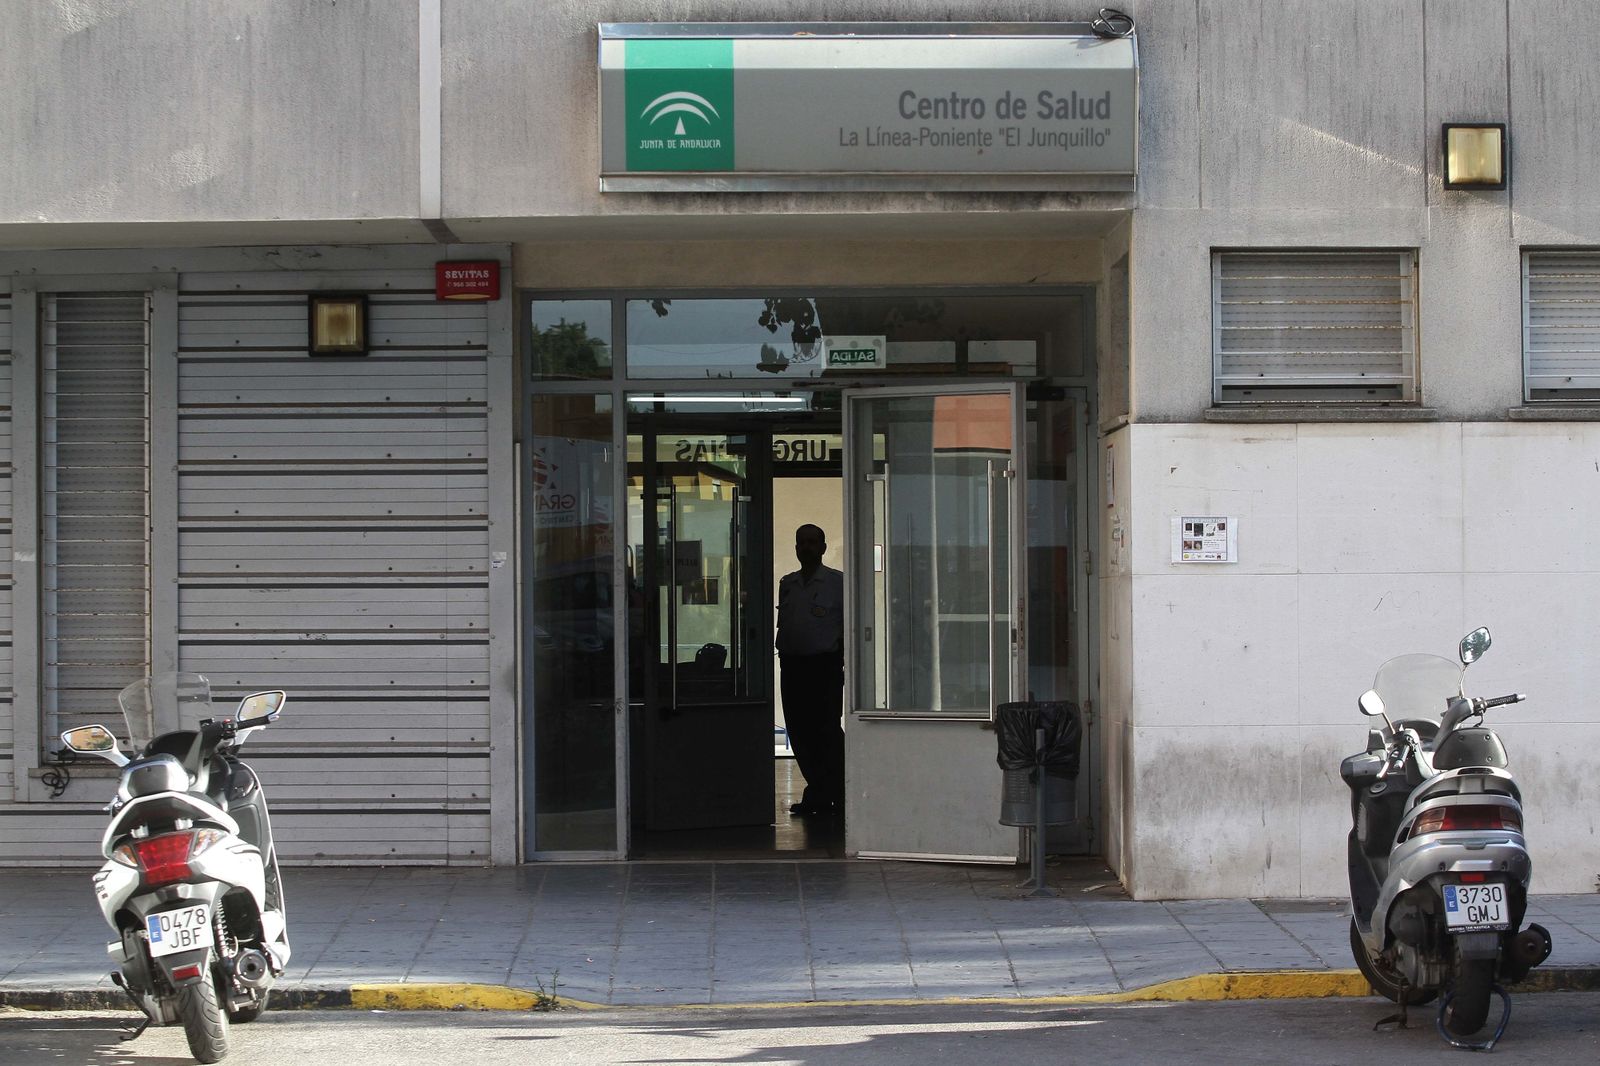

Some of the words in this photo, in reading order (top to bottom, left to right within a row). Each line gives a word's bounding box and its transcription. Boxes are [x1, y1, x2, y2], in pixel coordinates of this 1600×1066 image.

[899, 90, 986, 120] Centro
[995, 90, 1027, 120] de
[1036, 90, 1111, 120] Salud
[640, 139, 664, 149] JUNTA
[667, 139, 677, 149] DE
[680, 139, 721, 149] ANDALUCIA
[839, 127, 859, 147] La
[866, 126, 993, 147] Línea-Poniente
[999, 127, 1021, 147] "El
[1027, 127, 1111, 151] Junquillo"
[445, 271, 489, 279] SEVITAS
[1449, 900, 1456, 908] E
[1458, 886, 1503, 905] 3730
[160, 908, 207, 932] 0478
[1467, 904, 1500, 923] GMJ
[170, 926, 202, 949] JBF
